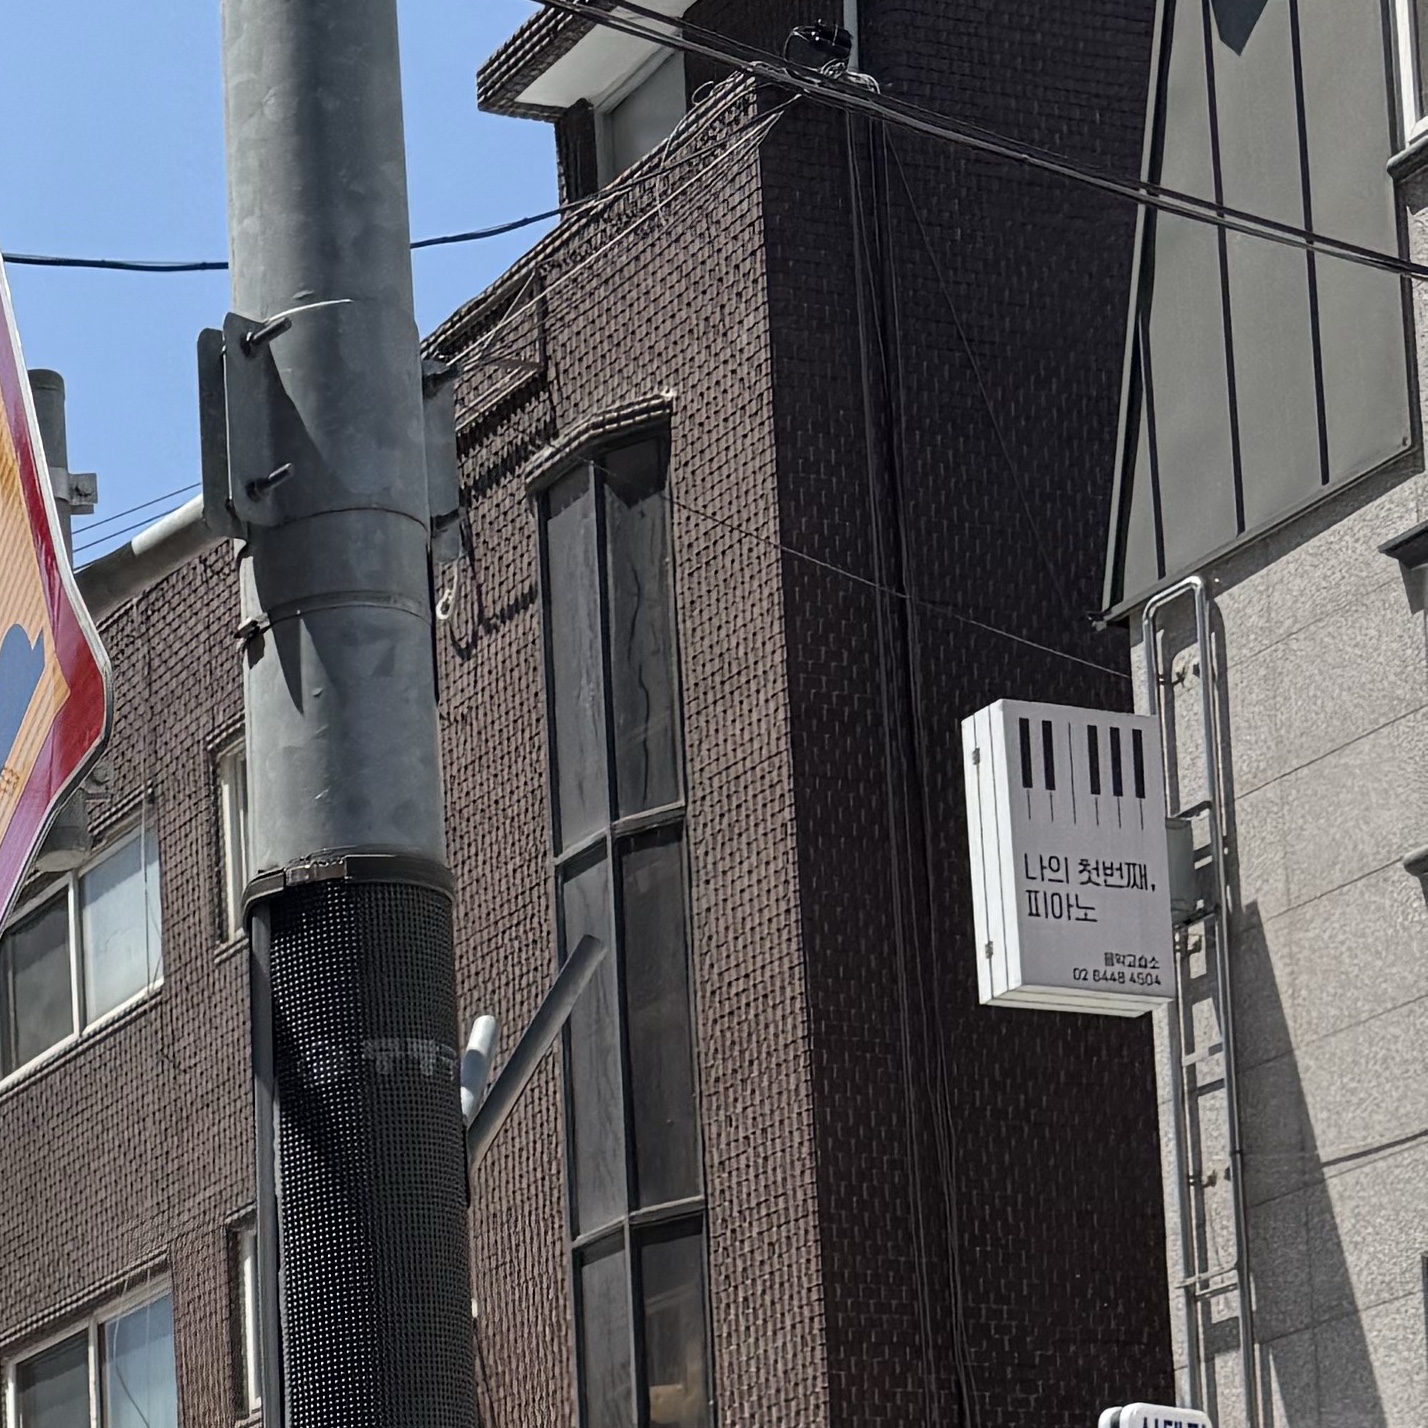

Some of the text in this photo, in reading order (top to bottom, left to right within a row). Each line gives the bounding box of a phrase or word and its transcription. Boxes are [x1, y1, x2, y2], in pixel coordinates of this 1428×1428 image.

[1023, 853, 1070, 884] 나의
[1025, 889, 1098, 922] 피아노
[1073, 967, 1089, 981] 02
